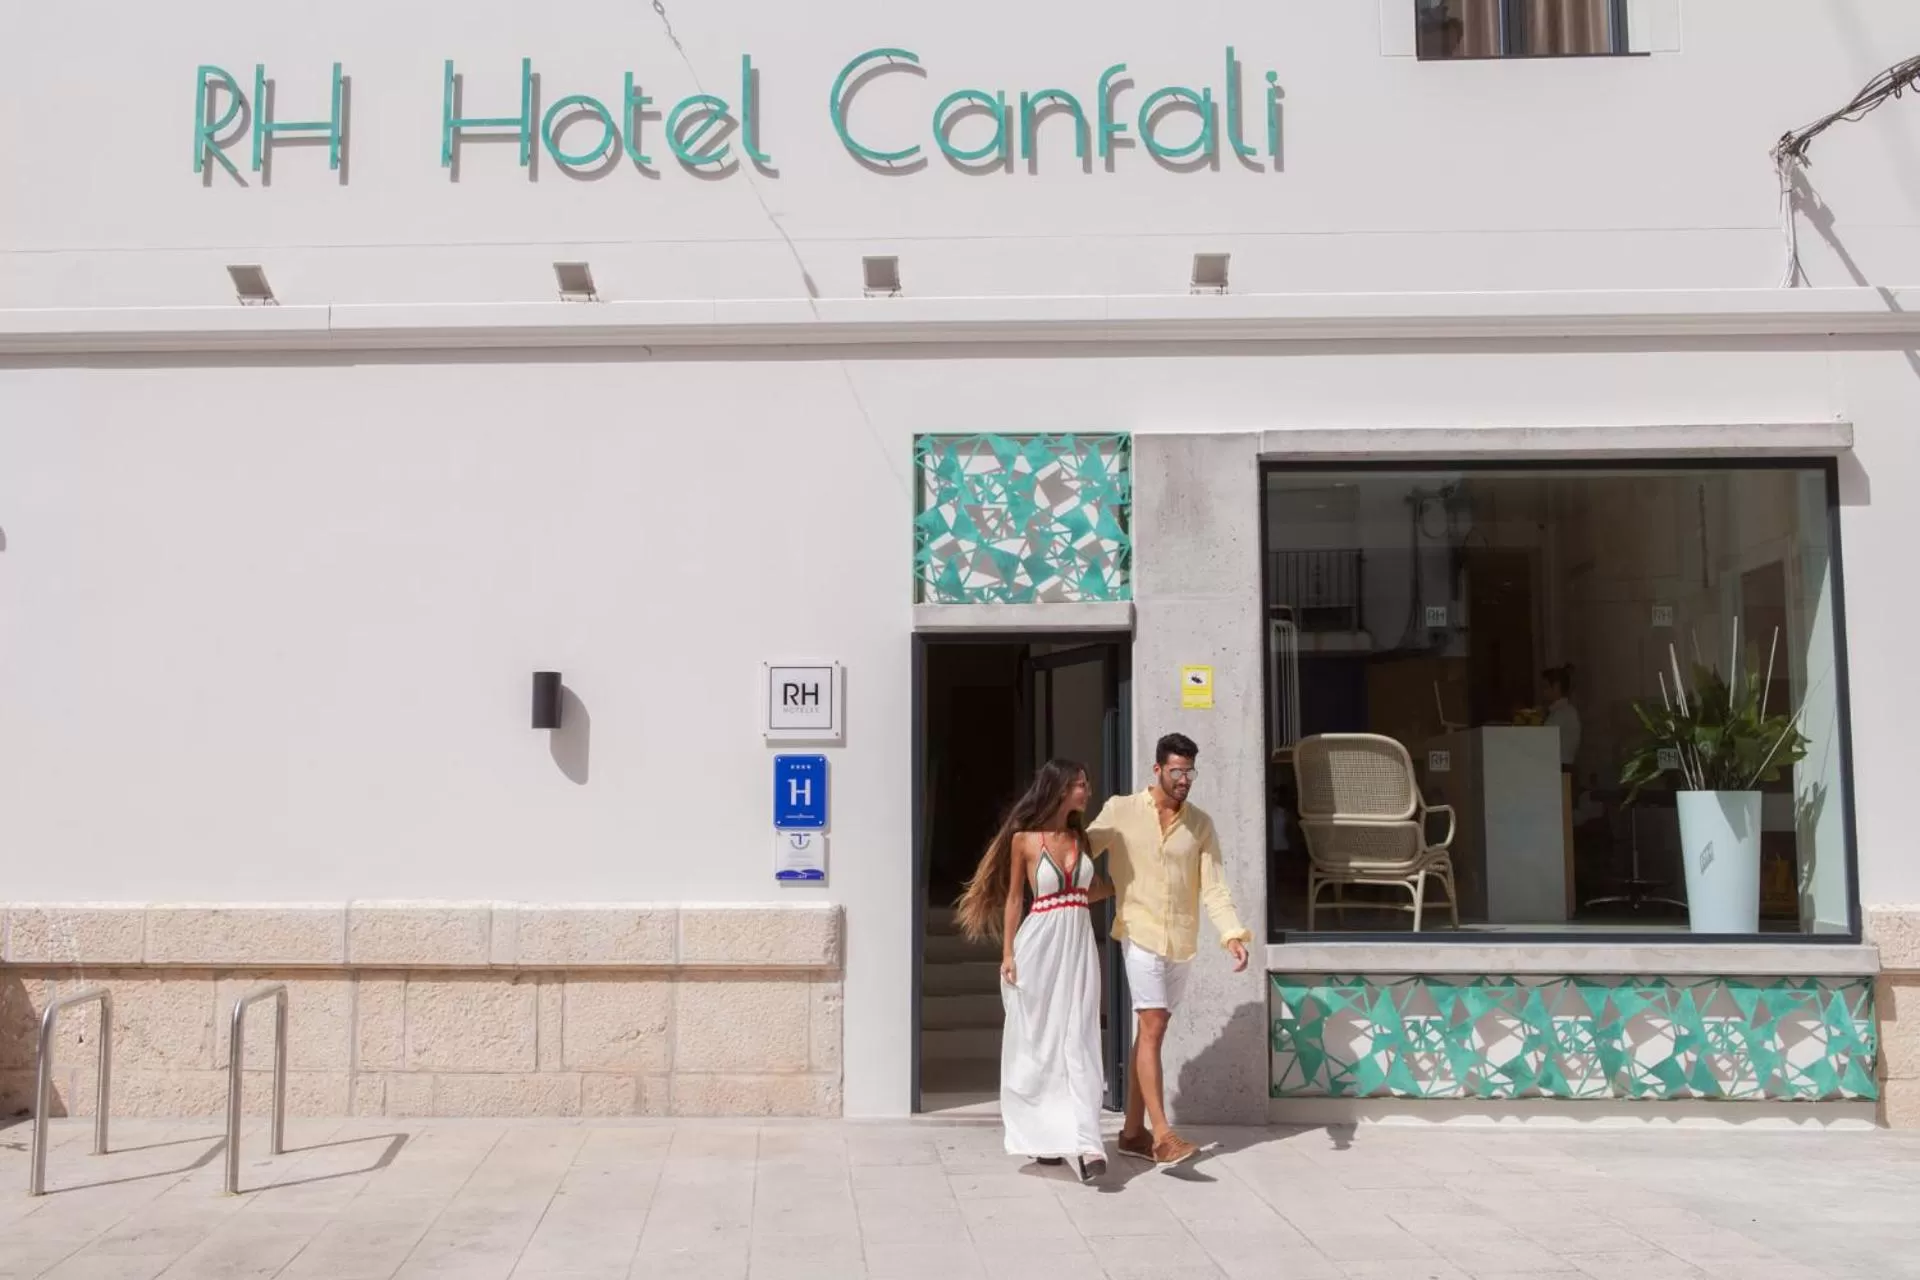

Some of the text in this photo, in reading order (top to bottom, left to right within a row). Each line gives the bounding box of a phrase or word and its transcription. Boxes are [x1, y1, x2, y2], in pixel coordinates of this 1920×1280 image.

[193, 45, 1278, 173] RH Hotel Canfali
[783, 682, 819, 706] RH
